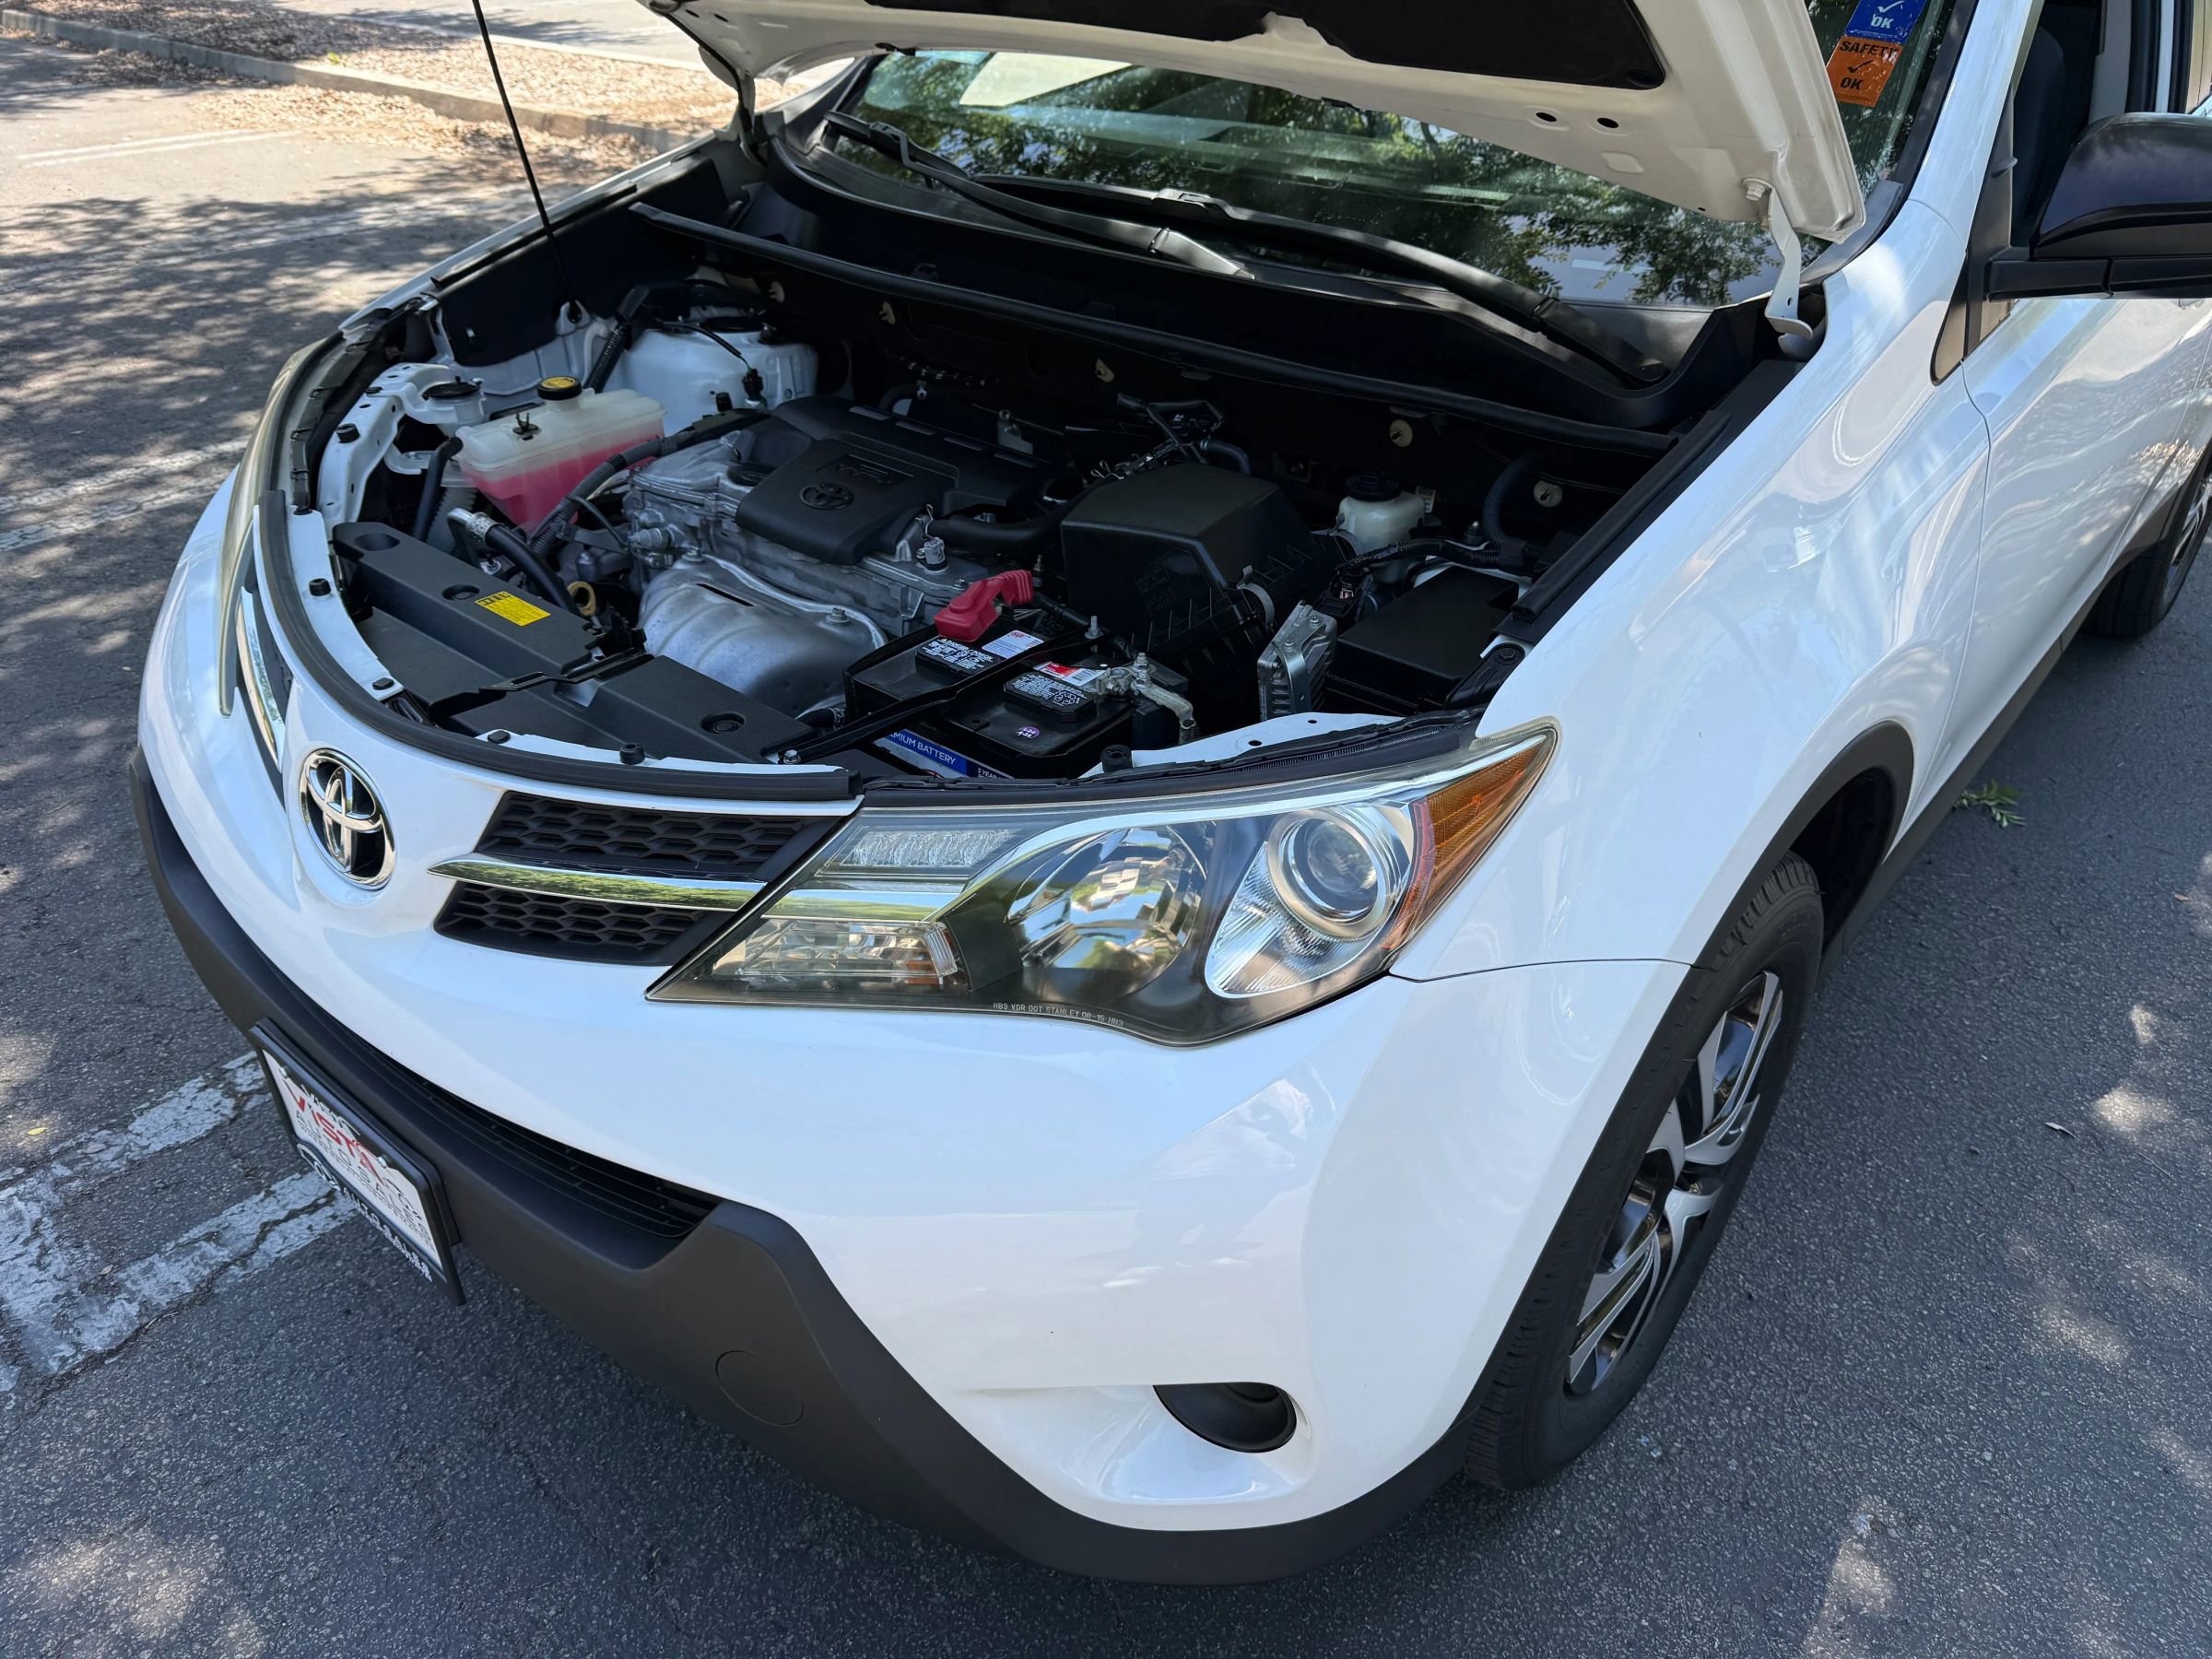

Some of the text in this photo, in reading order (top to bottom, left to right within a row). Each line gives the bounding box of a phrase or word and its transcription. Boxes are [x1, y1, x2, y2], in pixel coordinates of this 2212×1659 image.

[1871, 14, 1894, 29] OK
[1840, 41, 1899, 58] SAFETY
[1841, 77, 1862, 89] OK
[917, 741, 956, 765] BATTERY
[1045, 1006, 1080, 1018] STANLEY
[283, 1079, 385, 1186] VISTA
